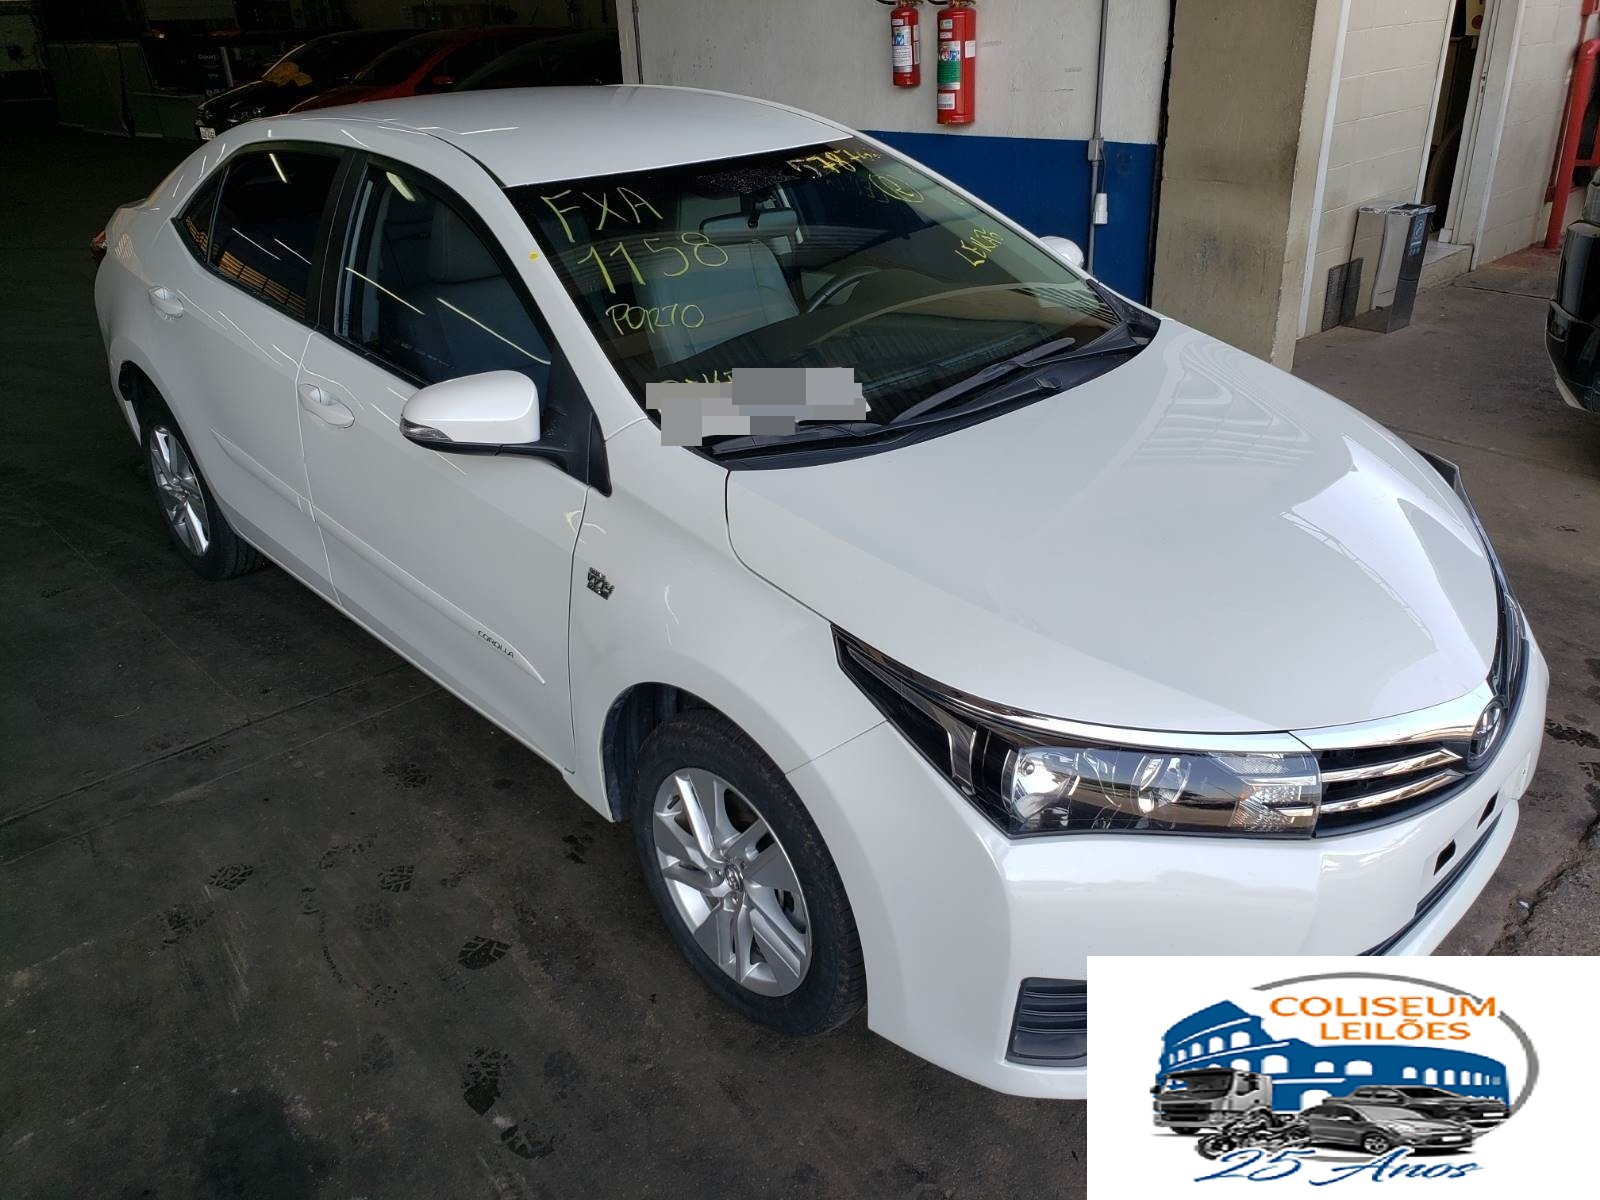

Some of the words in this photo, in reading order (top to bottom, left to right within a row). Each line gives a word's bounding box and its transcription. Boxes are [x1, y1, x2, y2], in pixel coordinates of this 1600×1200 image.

[540, 187, 664, 243] FXA
[577, 232, 729, 293] 1158
[605, 303, 705, 335] PORTO
[478, 630, 514, 658] COROLLA
